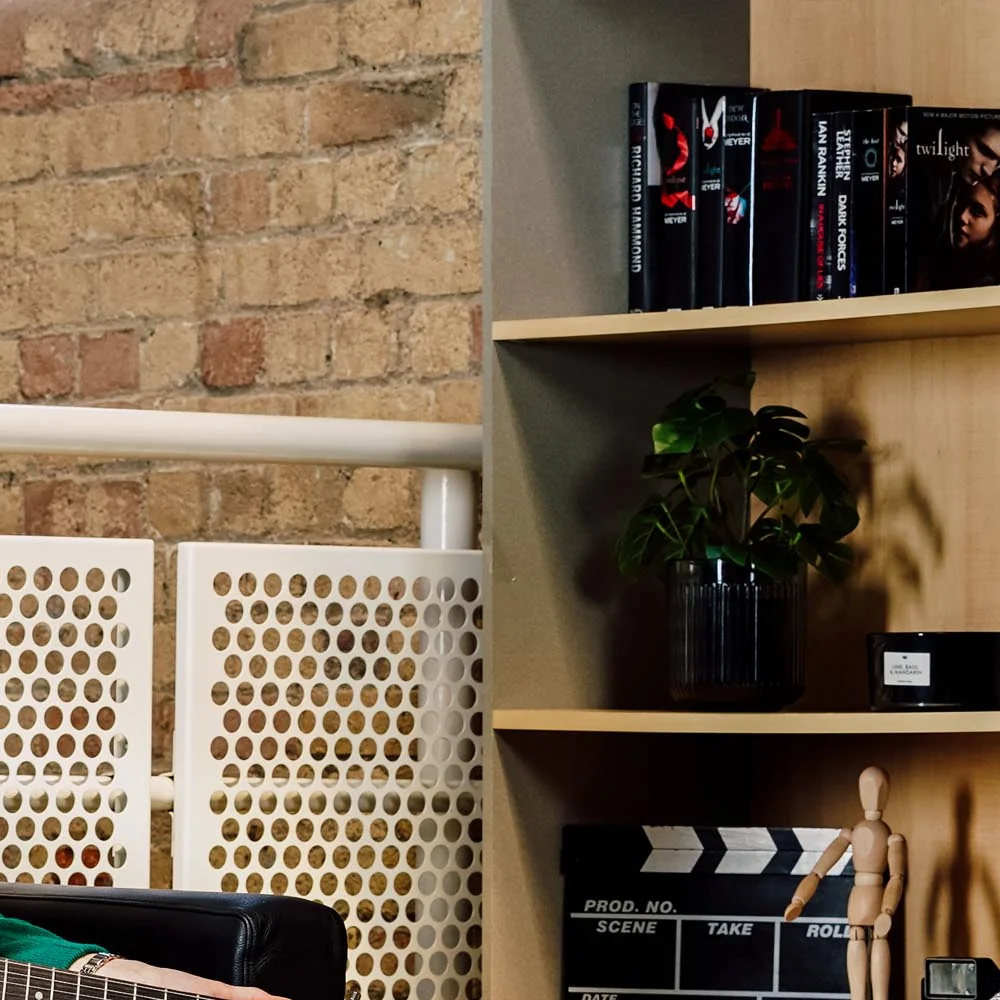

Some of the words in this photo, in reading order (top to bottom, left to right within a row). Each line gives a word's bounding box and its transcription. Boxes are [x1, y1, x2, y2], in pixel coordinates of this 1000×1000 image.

[818, 121, 827, 144] IAN
[916, 128, 970, 162] twilight
[631, 145, 642, 203] RICHARD
[817, 147, 827, 196] RANKIN
[835, 131, 844, 180] LEATHER
[842, 129, 852, 181] STEPHEN
[838, 194, 847, 227] DARK
[631, 206, 642, 273] HAMMOND
[837, 228, 847, 272] FORCES
[584, 899, 639, 913] PROD.
[645, 900, 677, 914] NO.
[596, 920, 658, 934] SCENE
[707, 922, 754, 936] TAKE
